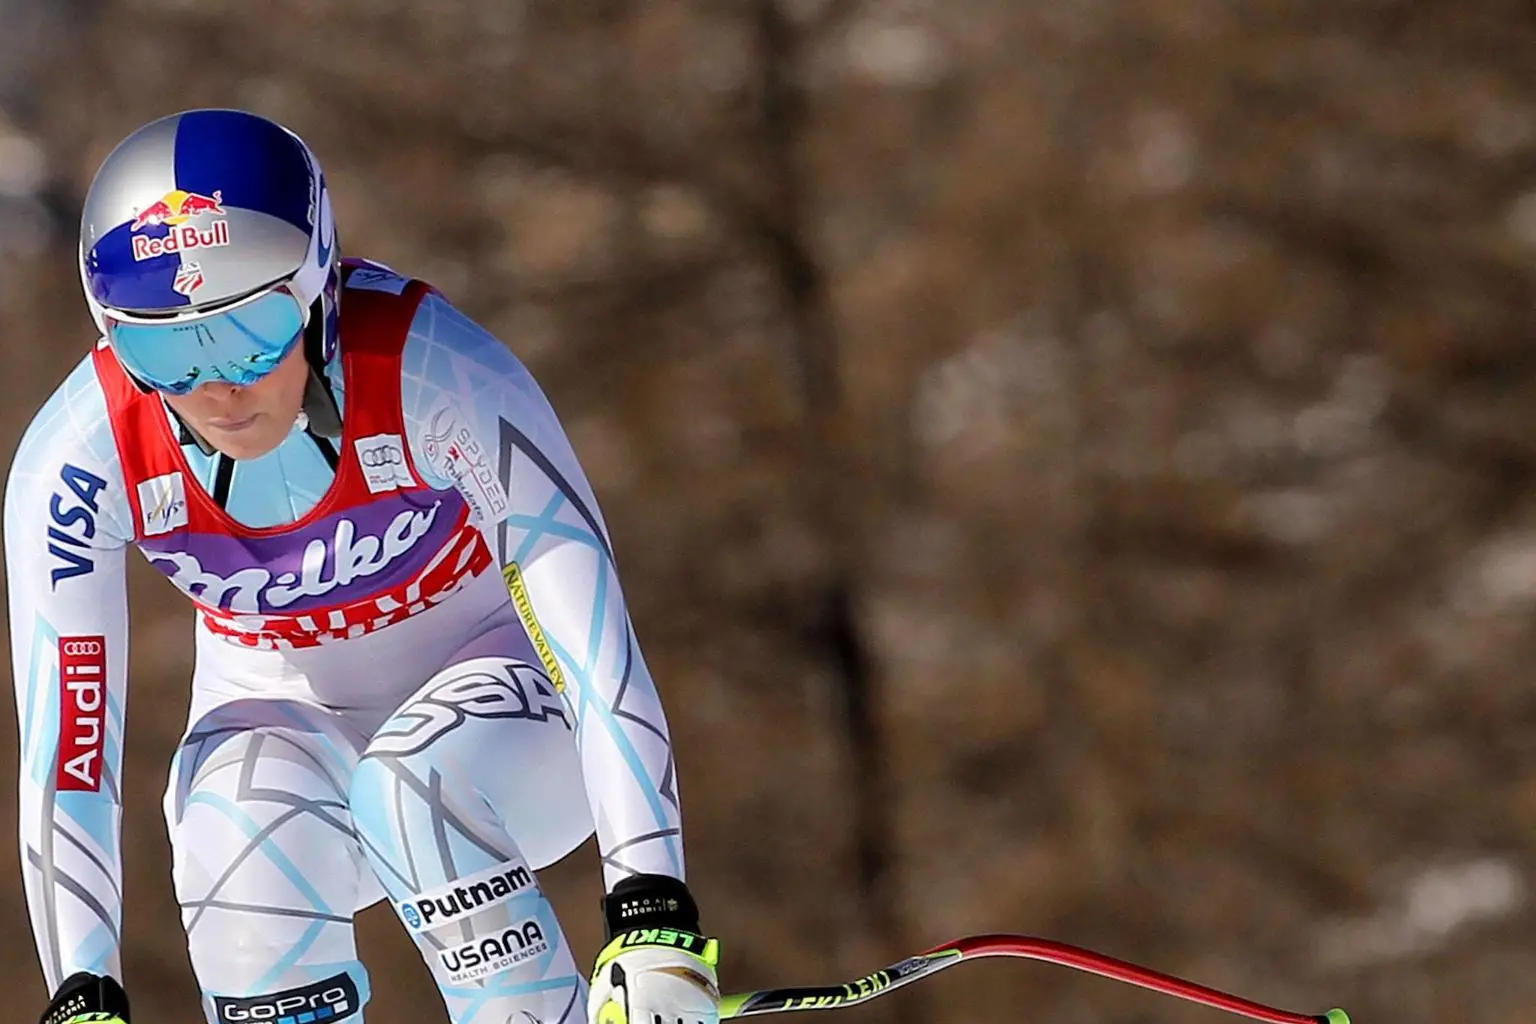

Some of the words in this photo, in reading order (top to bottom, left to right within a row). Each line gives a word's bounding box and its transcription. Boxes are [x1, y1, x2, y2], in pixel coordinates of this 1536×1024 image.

[134, 230, 178, 260] Red
[182, 222, 228, 248] Bull
[48, 462, 107, 592] VISA
[140, 500, 441, 613] Milka
[503, 567, 537, 633] NATURE
[533, 633, 563, 689] VALLEY
[64, 664, 101, 787] Audi
[418, 866, 532, 924] Putnam
[441, 920, 544, 972] USANA
[451, 965, 489, 983] HEALTH
[493, 941, 548, 970] SCIENCES
[626, 928, 695, 948] LEKI
[224, 987, 346, 1020] GoPro
[843, 970, 891, 1001] LEKI
